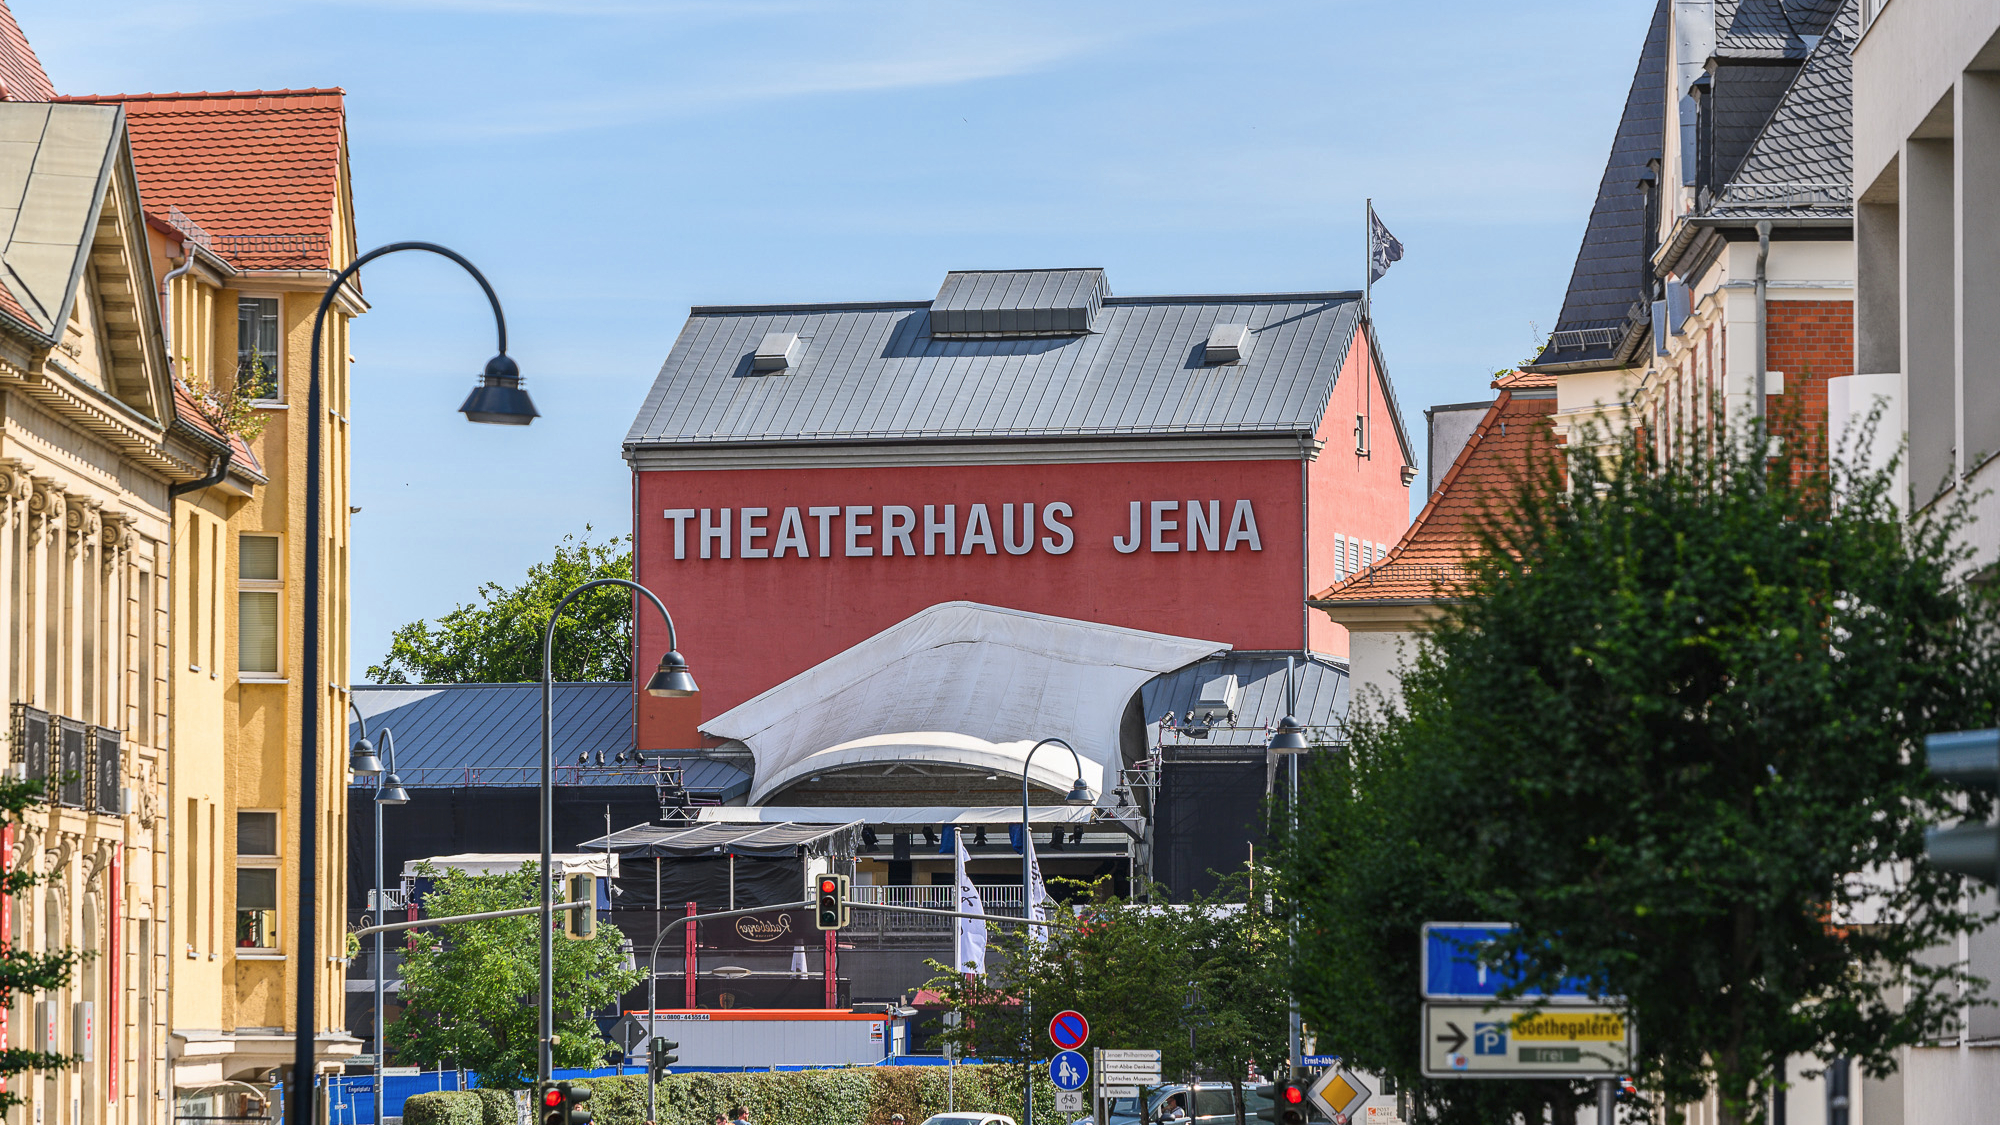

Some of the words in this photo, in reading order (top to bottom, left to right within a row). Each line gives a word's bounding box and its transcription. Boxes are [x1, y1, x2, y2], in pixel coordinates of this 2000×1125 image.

[663, 501, 1075, 560] THEATERHAUS
[1113, 499, 1263, 554] JENA
[1517, 1018, 1620, 1041] Goethegalerie
